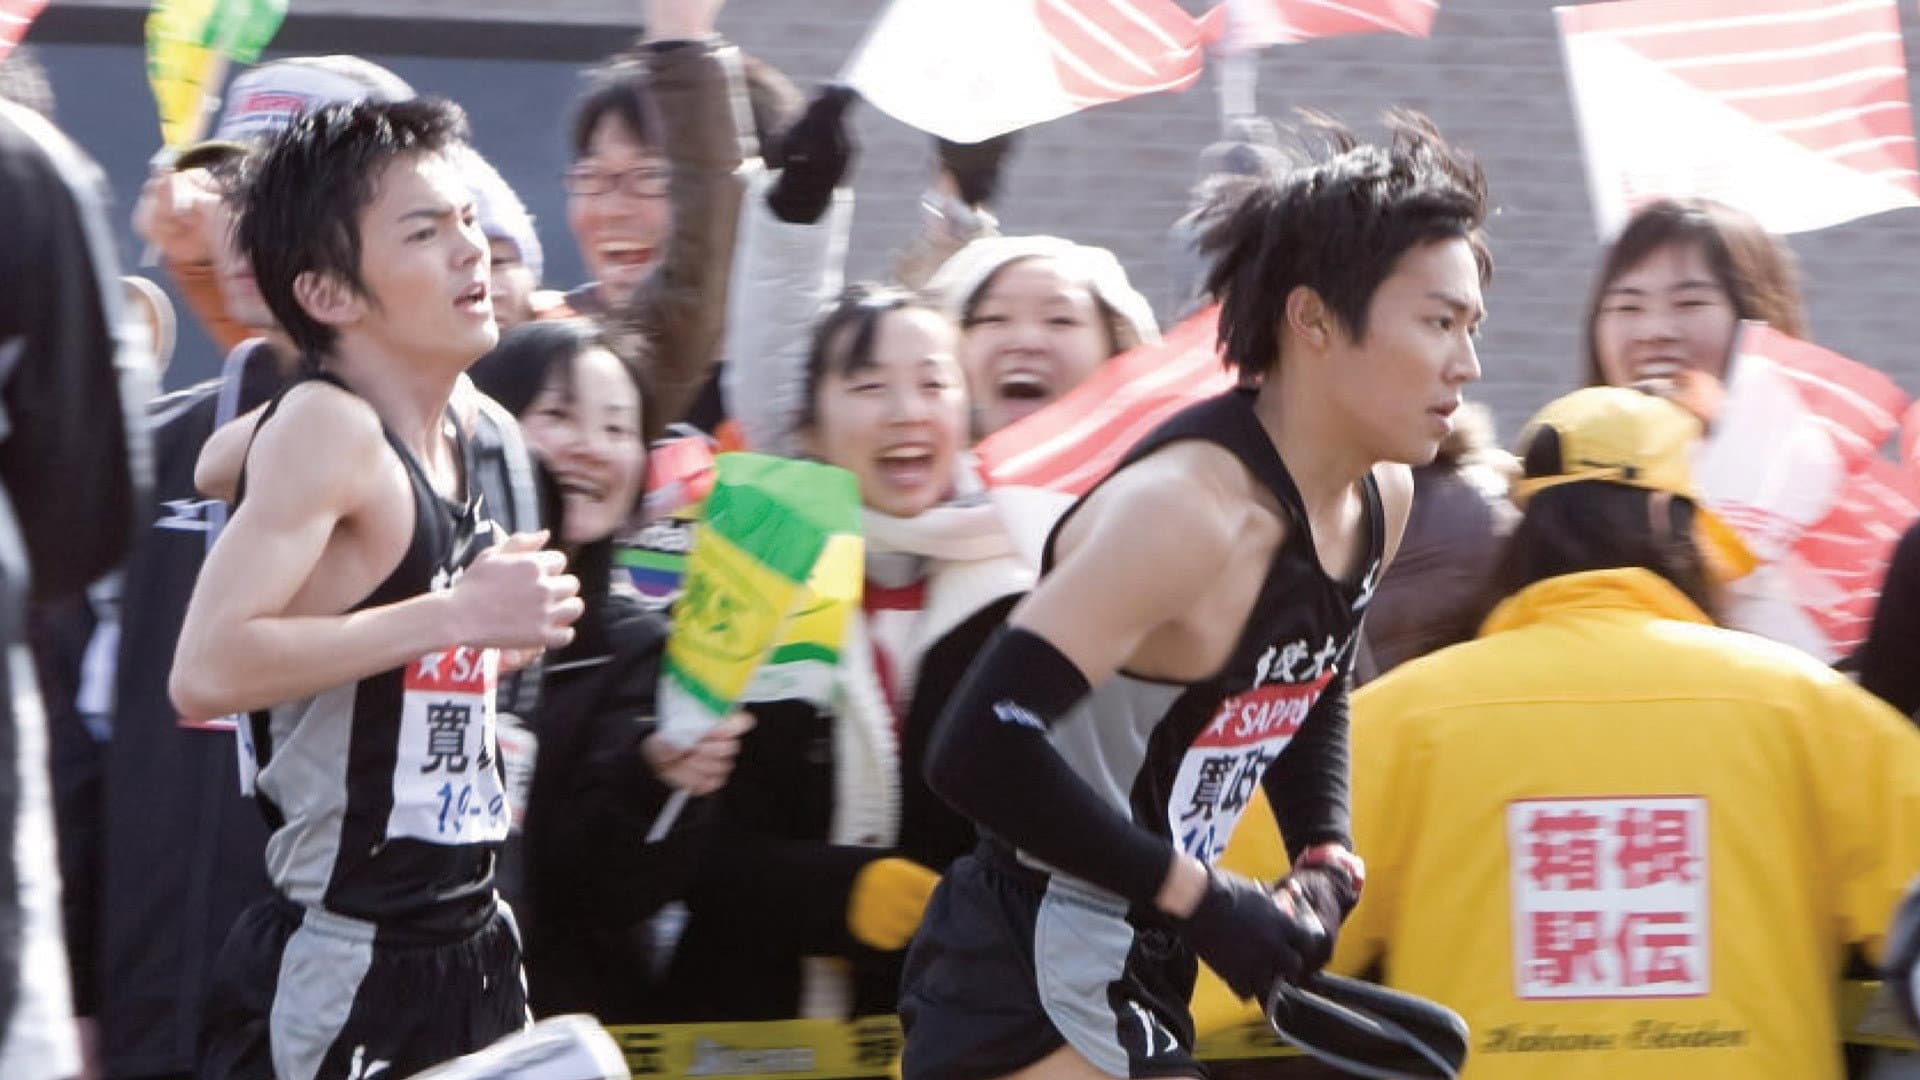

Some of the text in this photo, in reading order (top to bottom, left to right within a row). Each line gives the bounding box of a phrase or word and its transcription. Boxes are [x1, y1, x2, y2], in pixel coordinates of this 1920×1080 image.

[1234, 690, 1321, 737] SAPPO
[1527, 808, 1696, 891] 箱根
[1527, 910, 1694, 987] 駅伝
